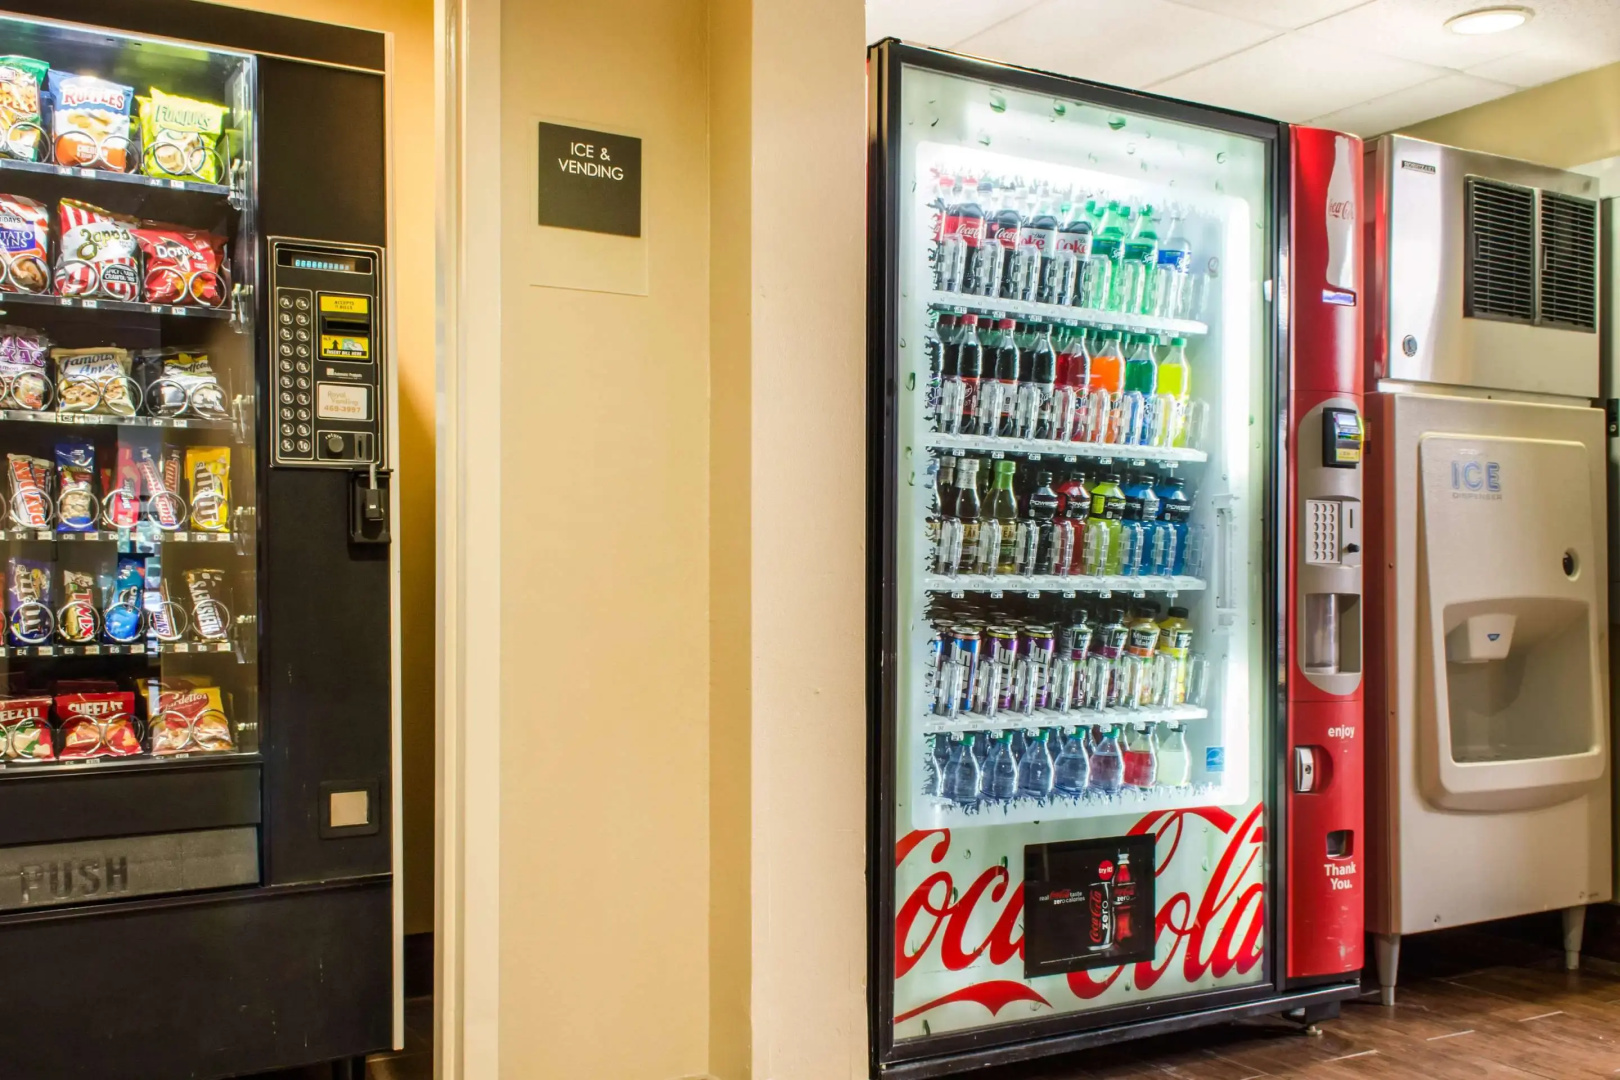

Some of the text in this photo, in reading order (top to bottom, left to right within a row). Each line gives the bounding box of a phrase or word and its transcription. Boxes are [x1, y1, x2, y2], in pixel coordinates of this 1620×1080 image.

[570, 141, 611, 162] ICE &
[557, 157, 624, 181] VENDING
[0, 230, 34, 241] TATO
[156, 245, 204, 260] Doritos
[1451, 460, 1501, 492] ICE
[1451, 491, 1503, 501] DISPENSER
[71, 588, 94, 638] TWIX
[189, 580, 220, 635] HERSHEY'S
[1327, 724, 1355, 738] enjoy
[1098, 867, 1107, 875] try
[1324, 861, 1356, 877] Thank
[20, 856, 129, 903] PUSH
[1330, 877, 1353, 890] You.
[1039, 894, 1050, 902] real
[1116, 895, 1131, 903] zero
[1101, 899, 1109, 931] zero
